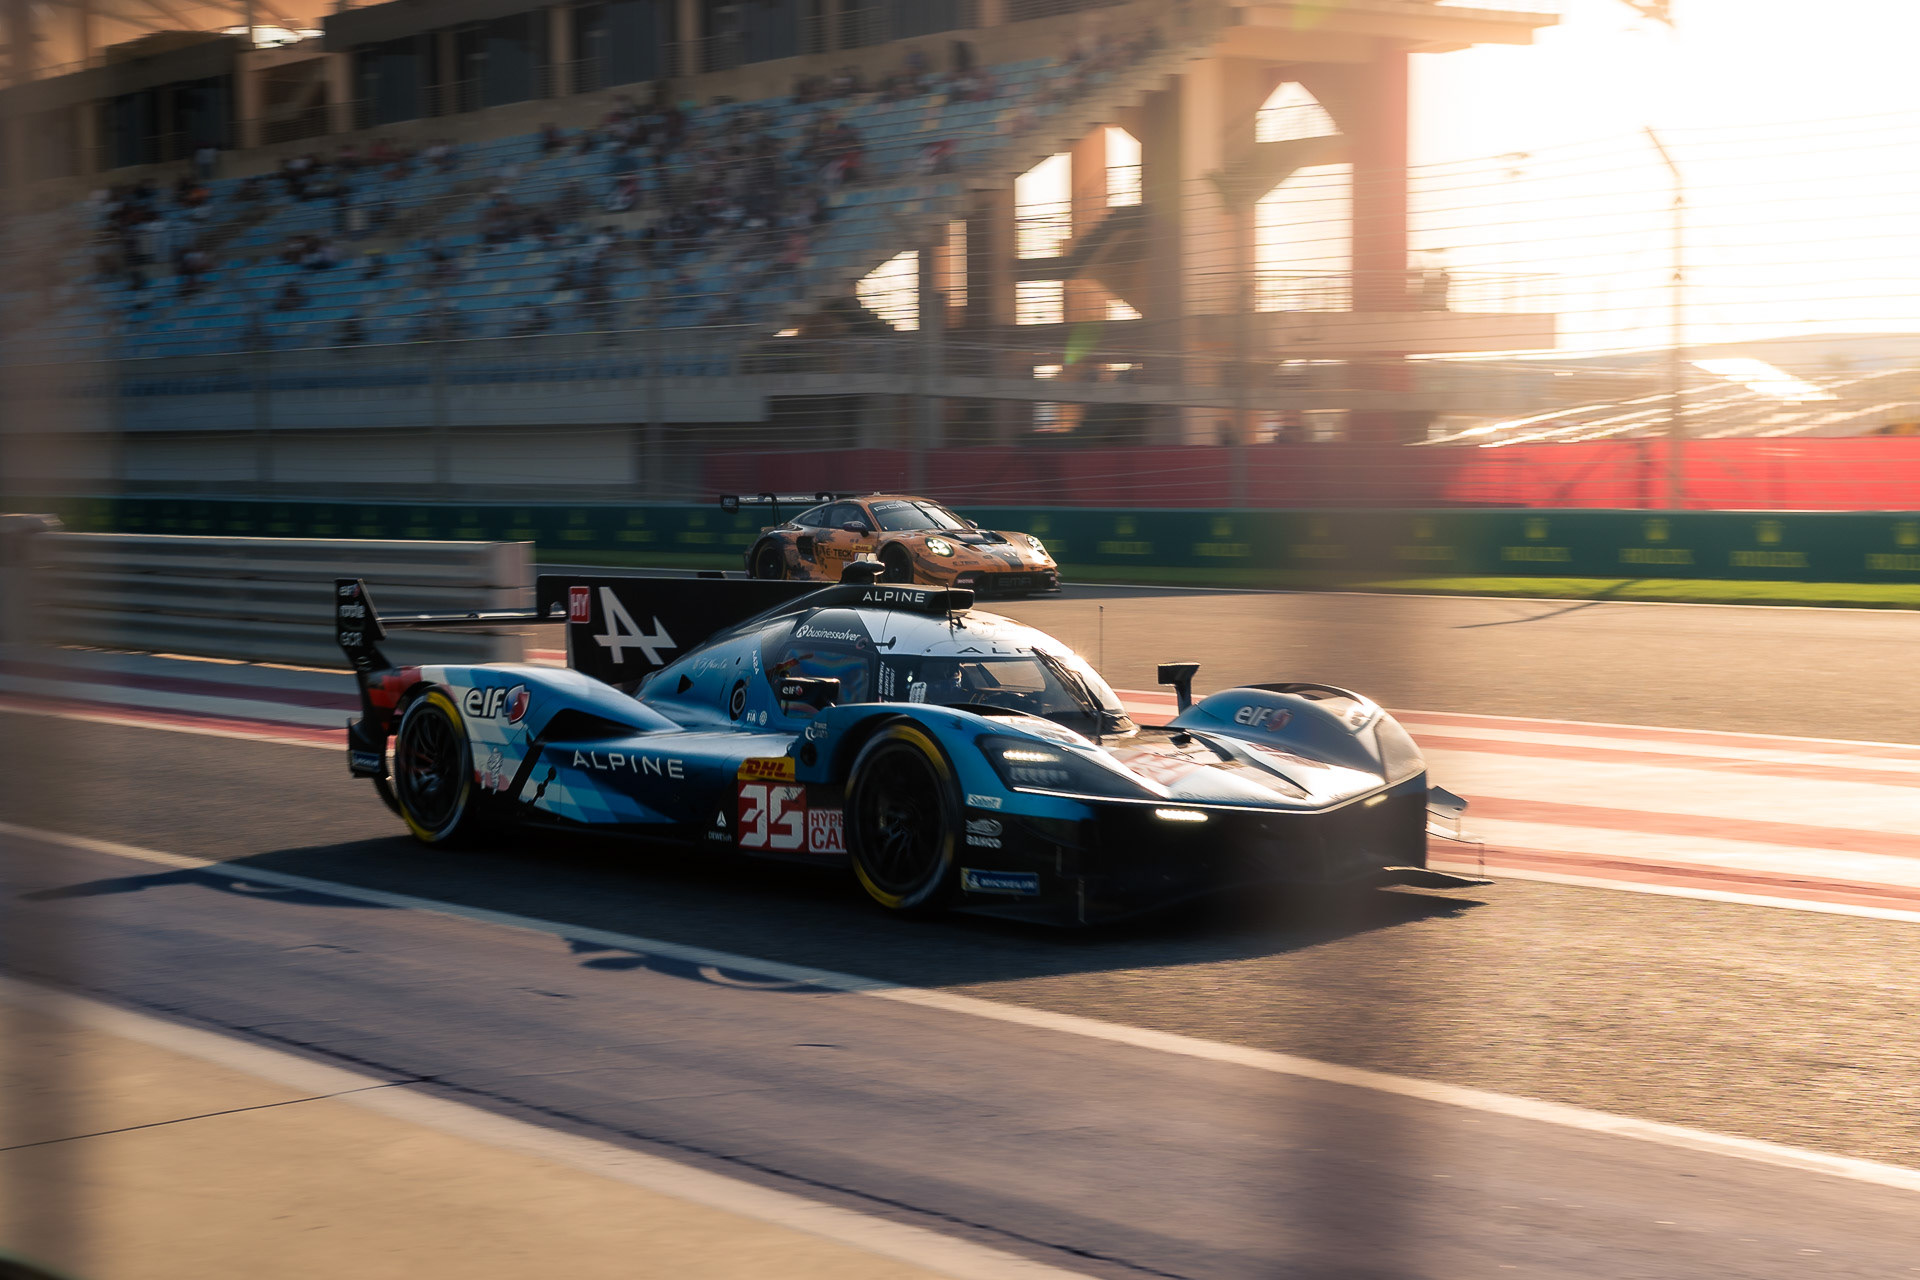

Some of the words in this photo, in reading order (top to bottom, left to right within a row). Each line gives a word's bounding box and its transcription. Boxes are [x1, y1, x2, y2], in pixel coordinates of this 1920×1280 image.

[571, 593, 589, 616] HY
[862, 591, 925, 603] ALPINE
[807, 626, 861, 641] businessolver
[782, 686, 795, 694] elf
[464, 687, 506, 718] elf
[1234, 706, 1273, 727] elf
[572, 750, 684, 780] ALPINE
[745, 758, 787, 778] DHL
[739, 784, 804, 850] 35
